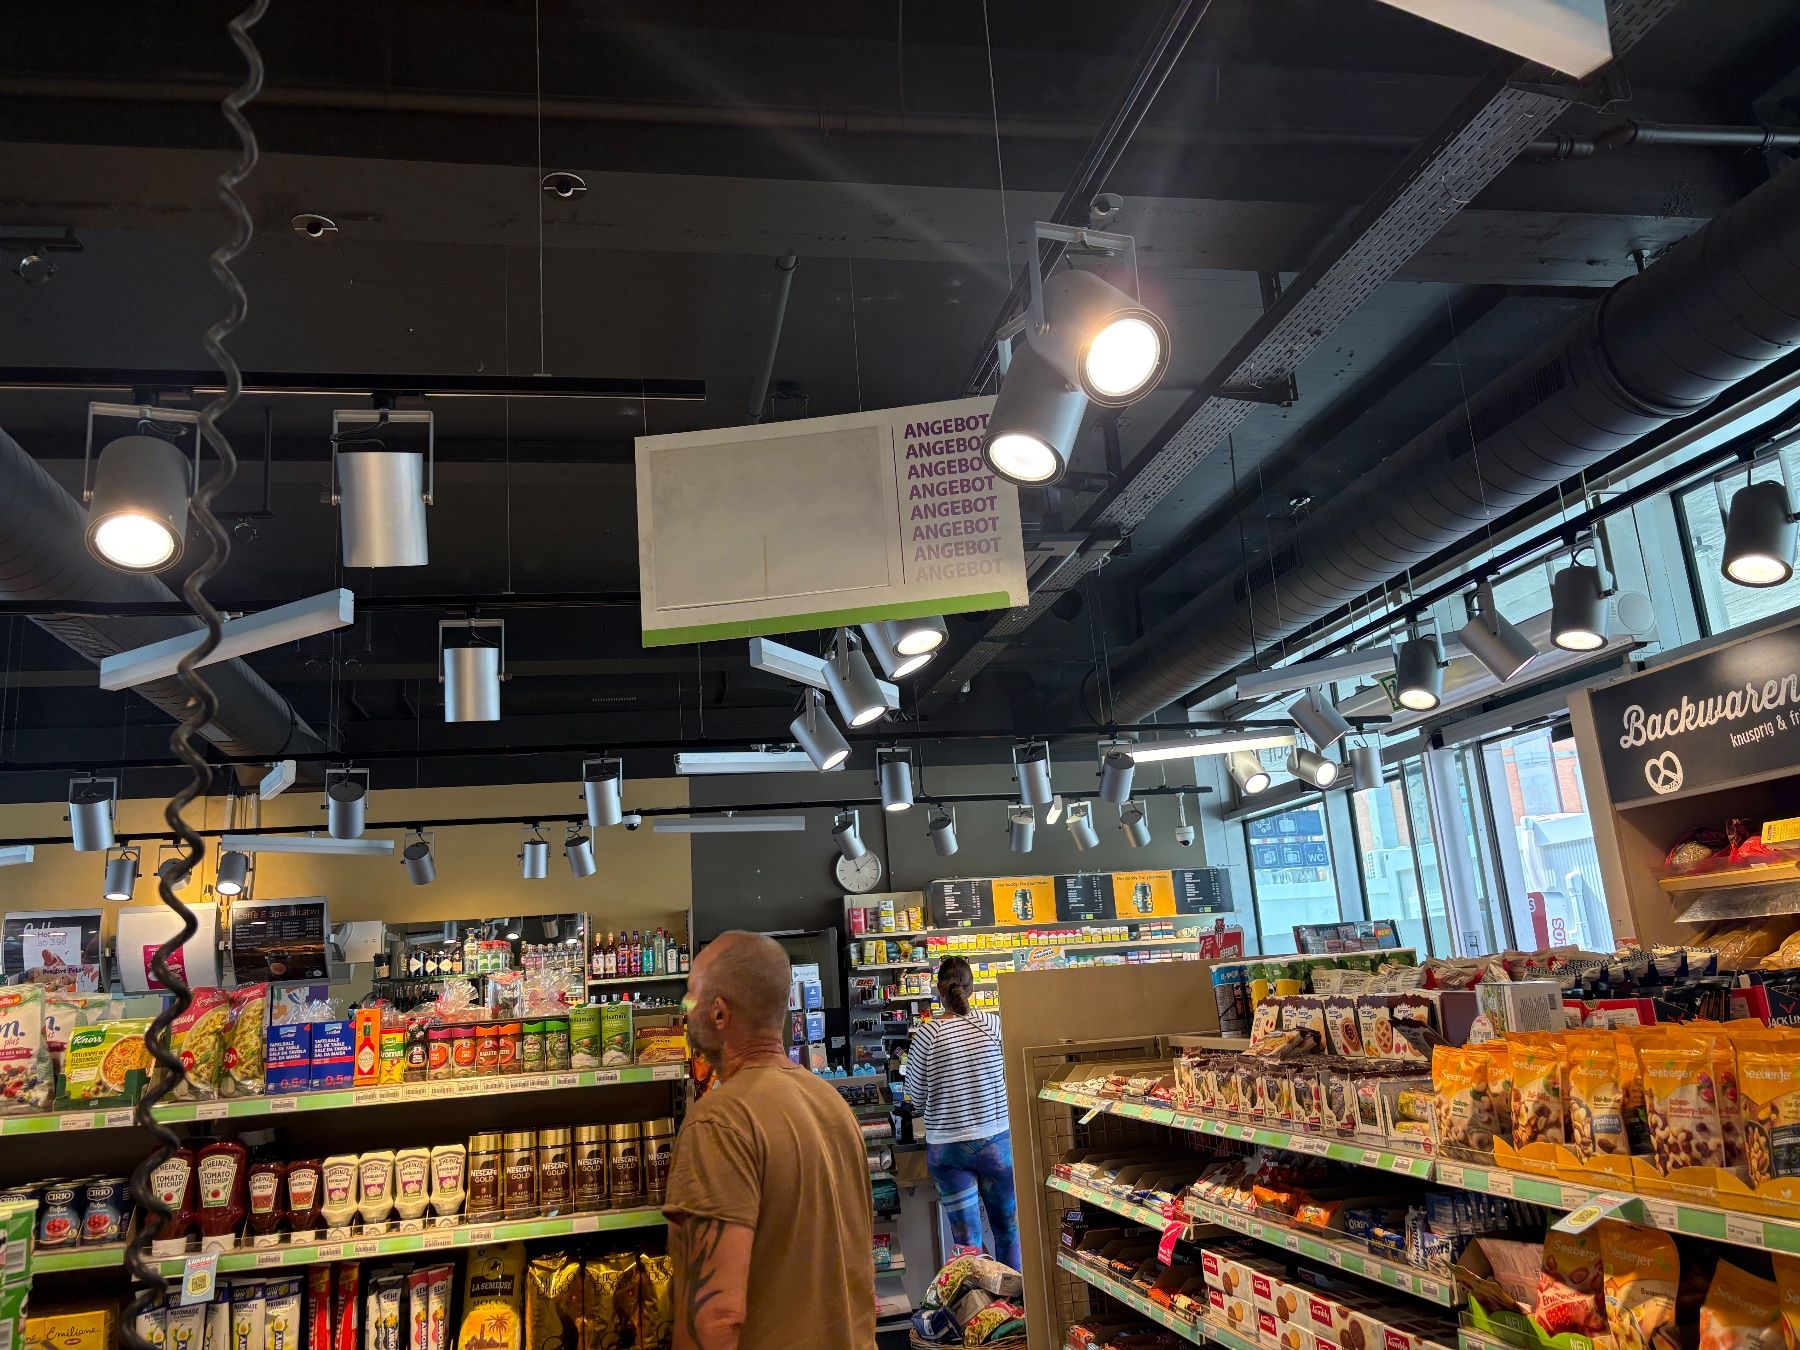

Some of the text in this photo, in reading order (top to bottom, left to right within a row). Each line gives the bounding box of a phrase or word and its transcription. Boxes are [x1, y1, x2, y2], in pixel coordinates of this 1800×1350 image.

[904, 414, 990, 439] ANGEBOT
[906, 435, 984, 459] ANGEBO
[908, 456, 985, 480] ANGEBO
[909, 475, 995, 500] ANGEBOT
[911, 496, 997, 520] ANGEBOT
[913, 516, 999, 541] ANGEBOT
[914, 537, 1001, 562] ANGEBOT
[916, 558, 1003, 583] ANGEBOT
[1620, 674, 1800, 749] Backwaren
[1730, 708, 1800, 748] knusprig & fr
[1308, 854, 1324, 862] WC
[1767, 1017, 1787, 1028] JACK
[73, 1035, 102, 1044] Knorr
[1648, 1067, 1693, 1079] Seeberger
[1744, 1066, 1791, 1082] Seeberger
[160, 1164, 181, 1172] HEINZ
[207, 1160, 228, 1169] HEINZ
[582, 1164, 600, 1172] GOLD
[617, 1162, 635, 1170] GOLD
[204, 1171, 230, 1179] TOMATO
[47, 1192, 71, 1200] CIRIO
[88, 1188, 110, 1196] CIRIO
[1608, 1241, 1653, 1266] Seeberger
[472, 1282, 512, 1291] LA SEMEUSE
[1714, 1286, 1768, 1316] Seeberger
[46, 1326, 98, 1340] Emiliane
